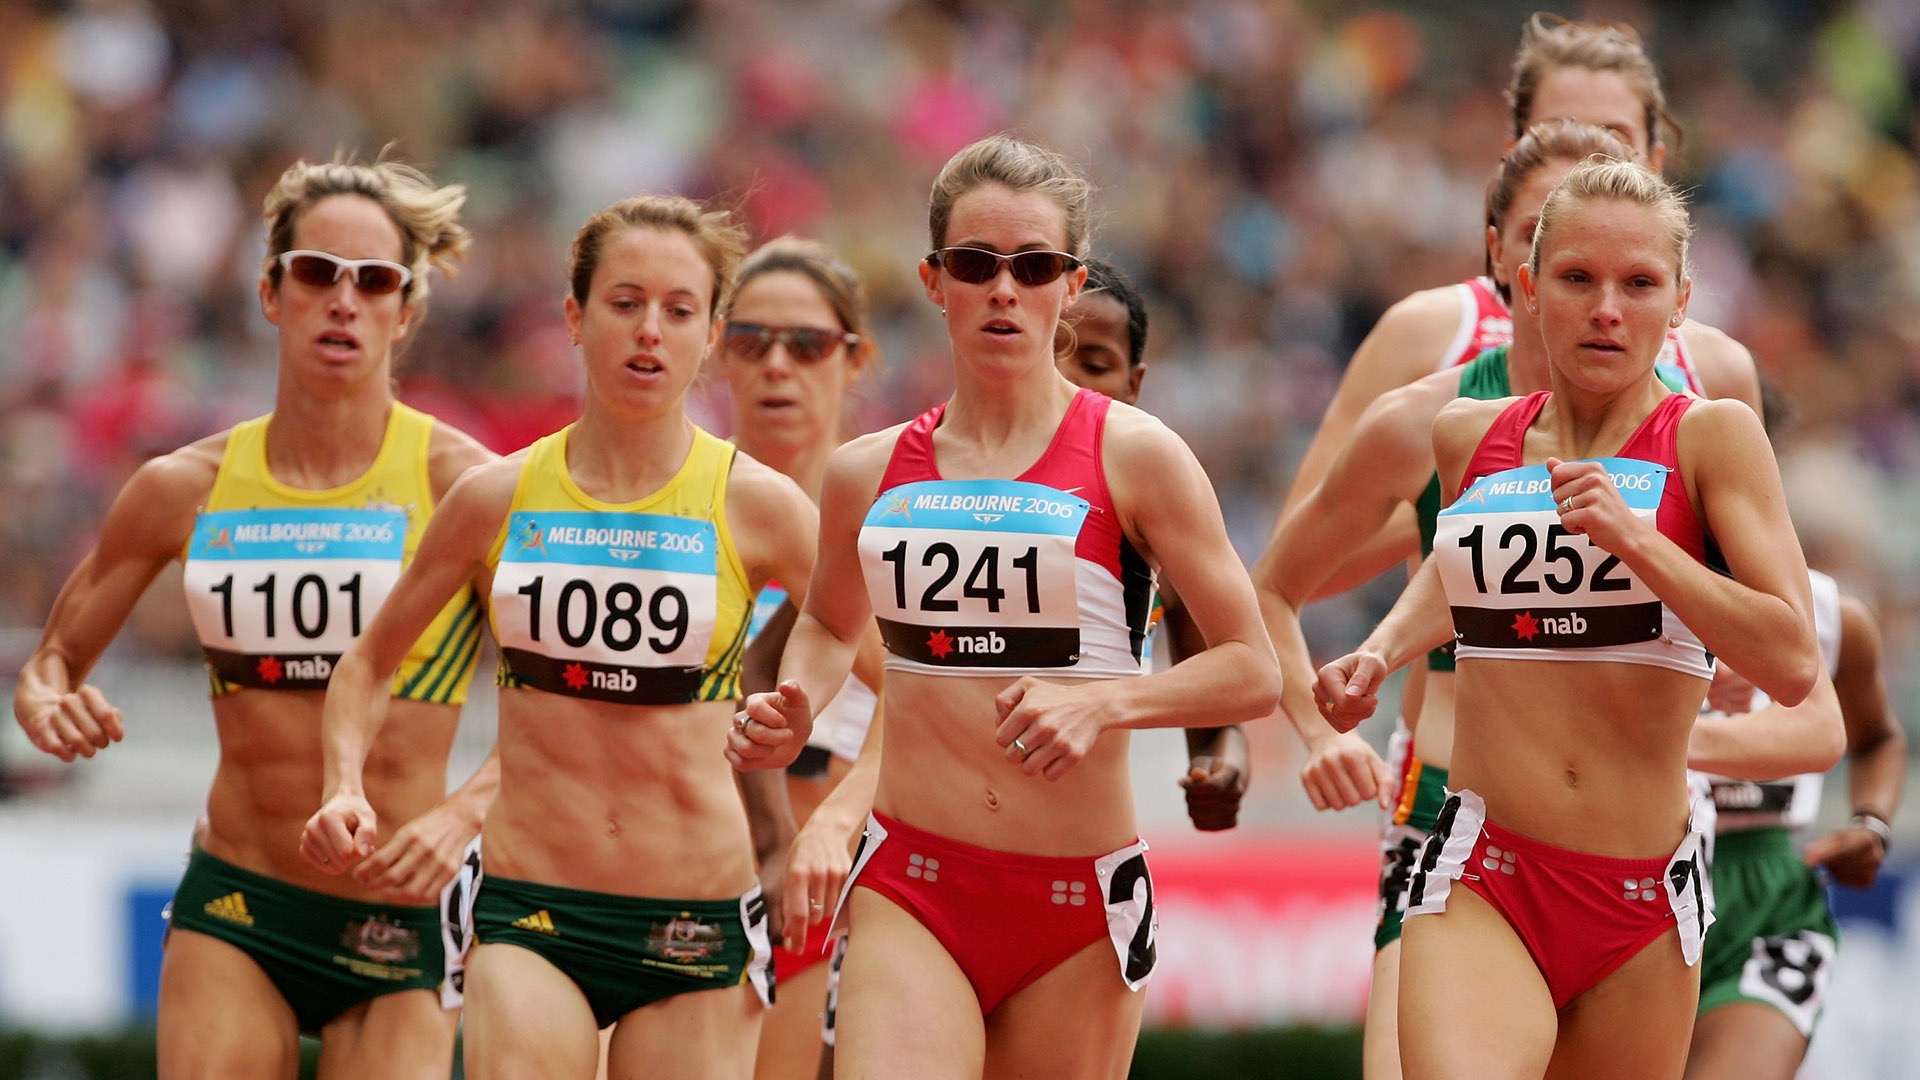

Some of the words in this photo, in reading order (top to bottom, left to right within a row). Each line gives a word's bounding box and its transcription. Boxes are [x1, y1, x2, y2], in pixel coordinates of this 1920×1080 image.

[1489, 479, 1551, 495] MELBO
[1608, 473, 1652, 490] 006
[914, 494, 1021, 512] MELBOURNE
[1024, 497, 1073, 518] 2006
[234, 523, 342, 542] MELBOURNE
[345, 521, 394, 542] 2006
[548, 527, 657, 548] MELBOURNE
[660, 532, 704, 553] 2006
[1458, 524, 1631, 595] 1252
[882, 540, 1040, 613] 1241
[210, 573, 361, 639] 1101
[518, 576, 689, 654] 1089
[1542, 612, 1587, 635] nab
[958, 631, 1005, 654] nab
[285, 657, 332, 680] nab
[592, 669, 637, 692] nab
[1108, 853, 1156, 982] 2
[1760, 934, 1822, 1005] 8
